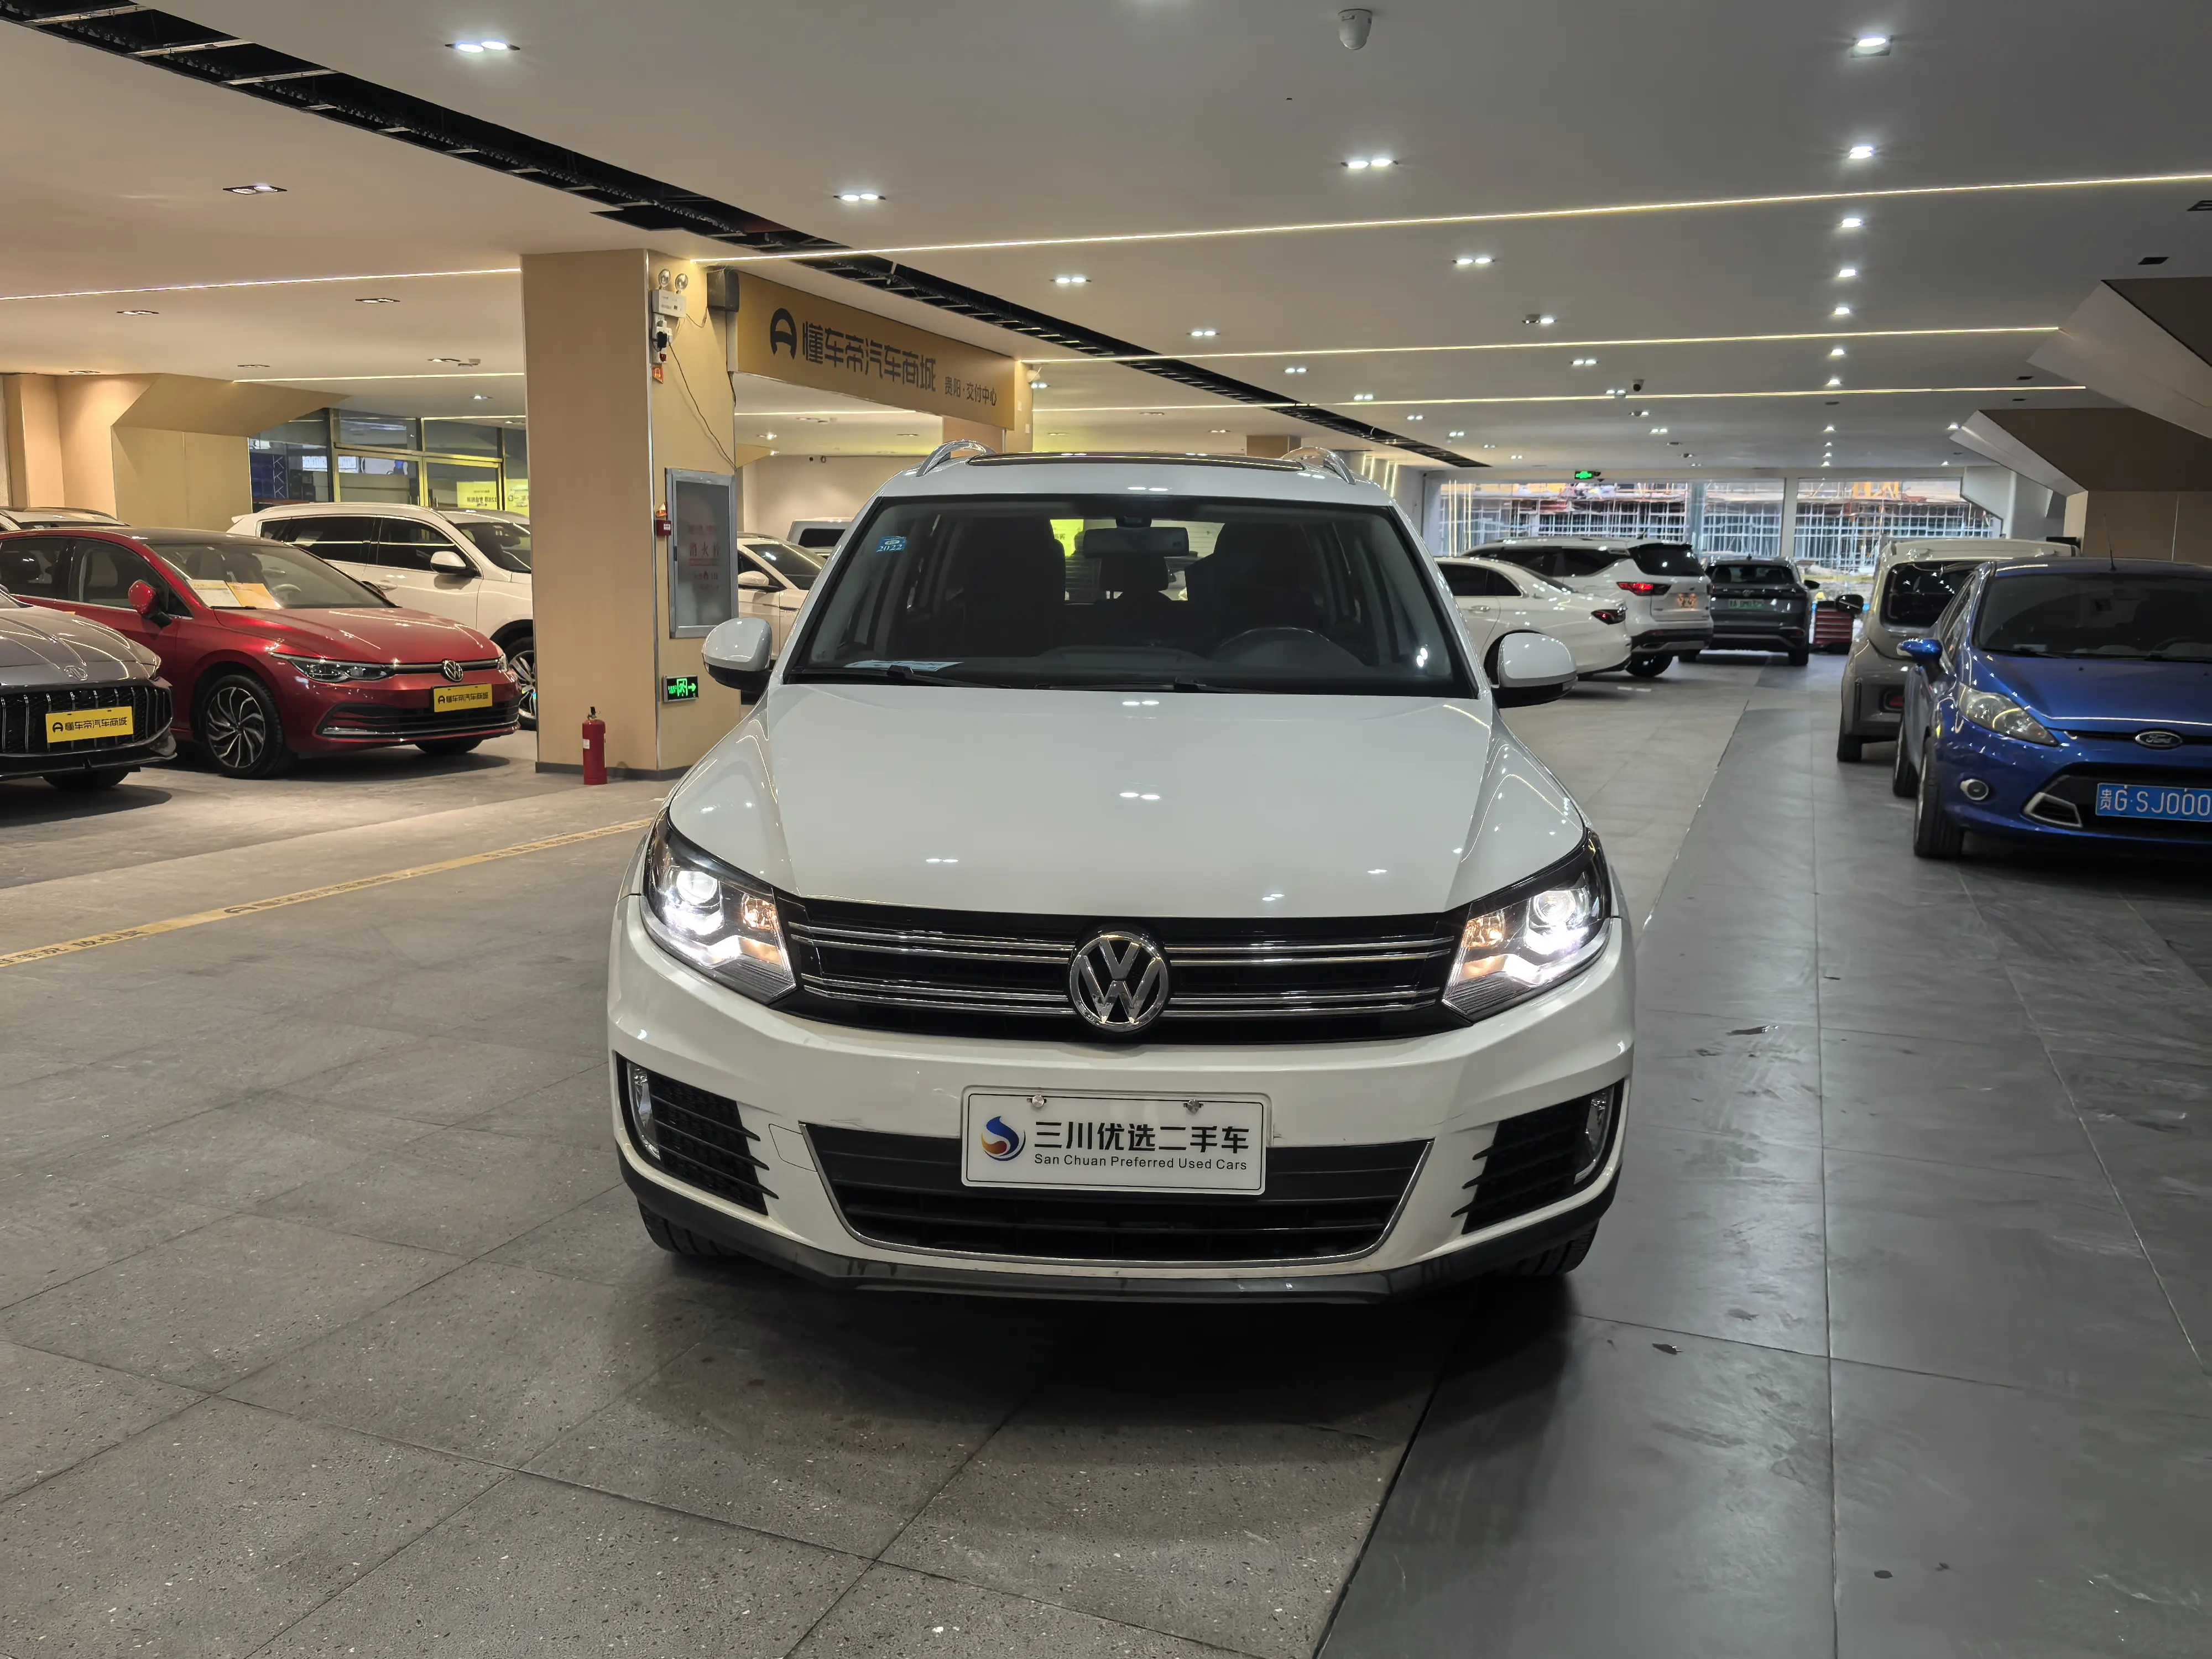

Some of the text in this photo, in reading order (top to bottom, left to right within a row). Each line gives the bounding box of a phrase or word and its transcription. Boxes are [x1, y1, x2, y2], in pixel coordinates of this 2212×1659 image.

[802, 321, 936, 392] 懂车帝汽车商城
[877, 544, 902, 552] 2022
[65, 717, 127, 731] 懂车帝汽车商城
[1035, 1121, 1249, 1154] 三川优选二手车
[1034, 1154, 1247, 1170] San Chuan Preferred Used Cars
